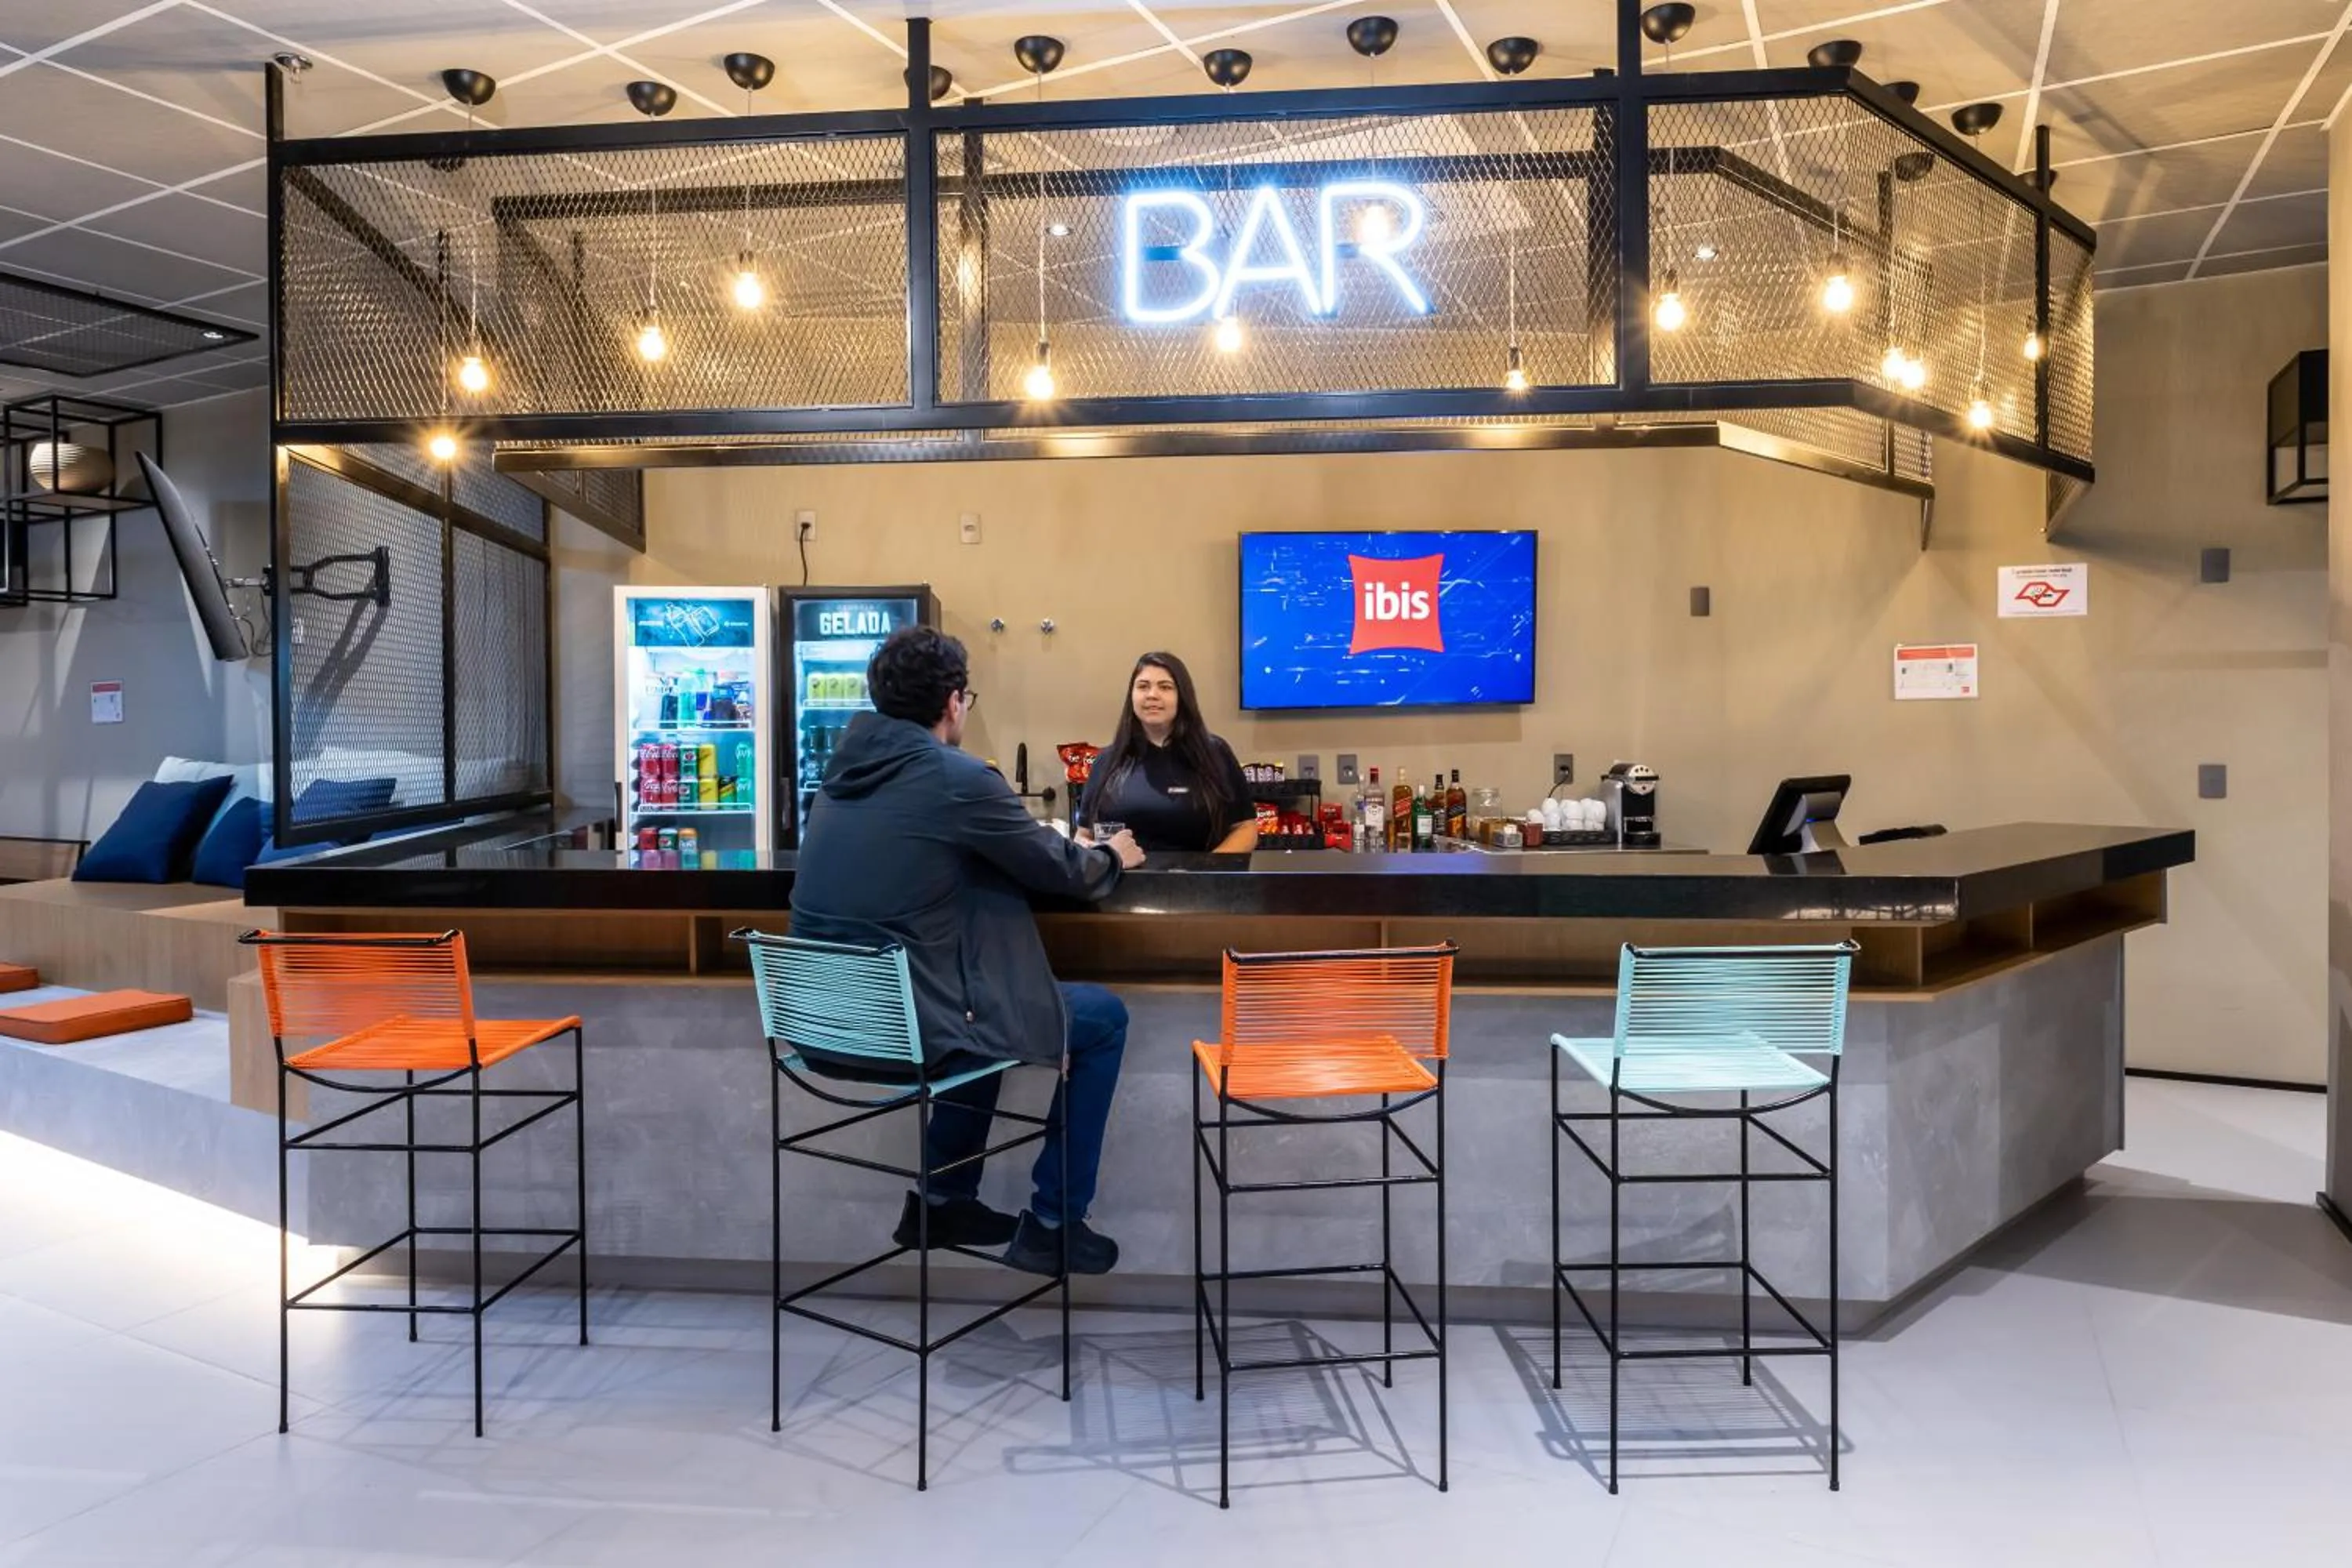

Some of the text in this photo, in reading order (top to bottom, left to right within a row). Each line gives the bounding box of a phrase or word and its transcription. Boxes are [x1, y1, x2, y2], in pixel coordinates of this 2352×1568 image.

[1123, 182, 1430, 322] BAR
[1363, 581, 1431, 621] ibis
[819, 611, 891, 635] GELADA
